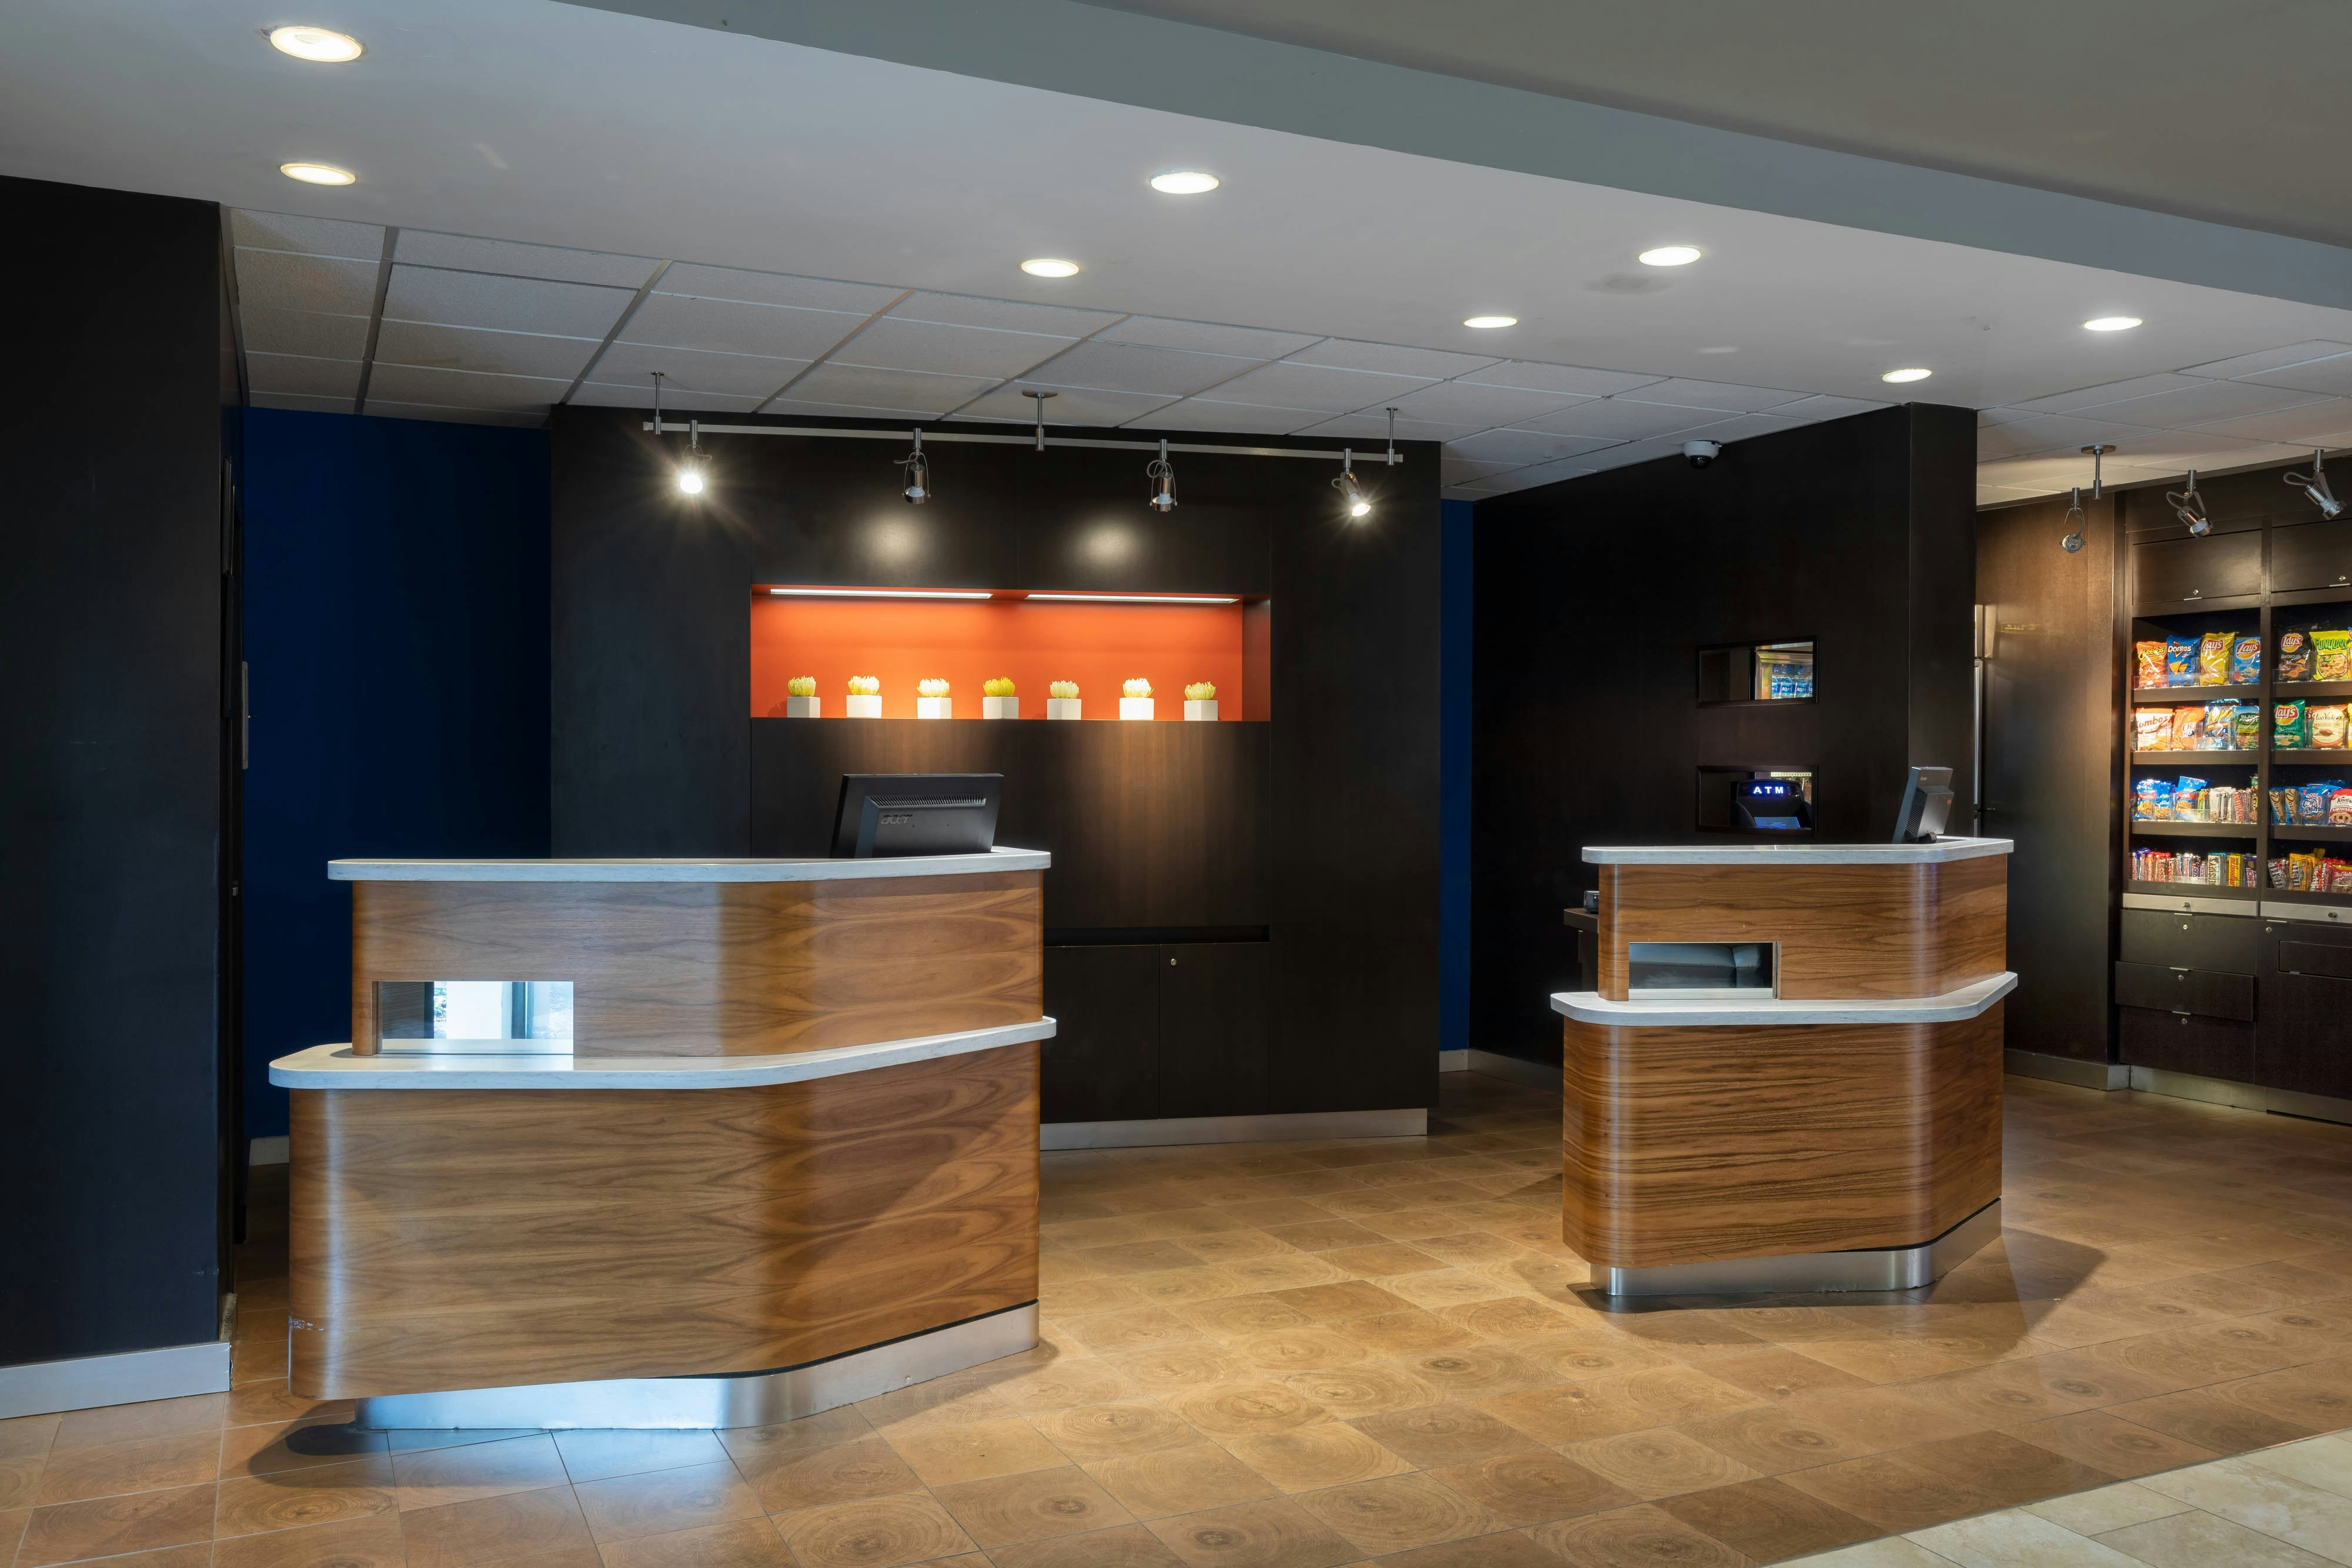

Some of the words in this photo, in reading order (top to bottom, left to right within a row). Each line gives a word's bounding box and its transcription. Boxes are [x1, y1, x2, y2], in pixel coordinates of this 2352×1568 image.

[2203, 639, 2223, 651] Lay's
[2283, 637, 2301, 647] Lay's
[2237, 643, 2259, 654] Lay's
[2274, 707, 2296, 718] Lay's
[2138, 716, 2169, 728] ombos
[881, 814, 913, 824] acer
